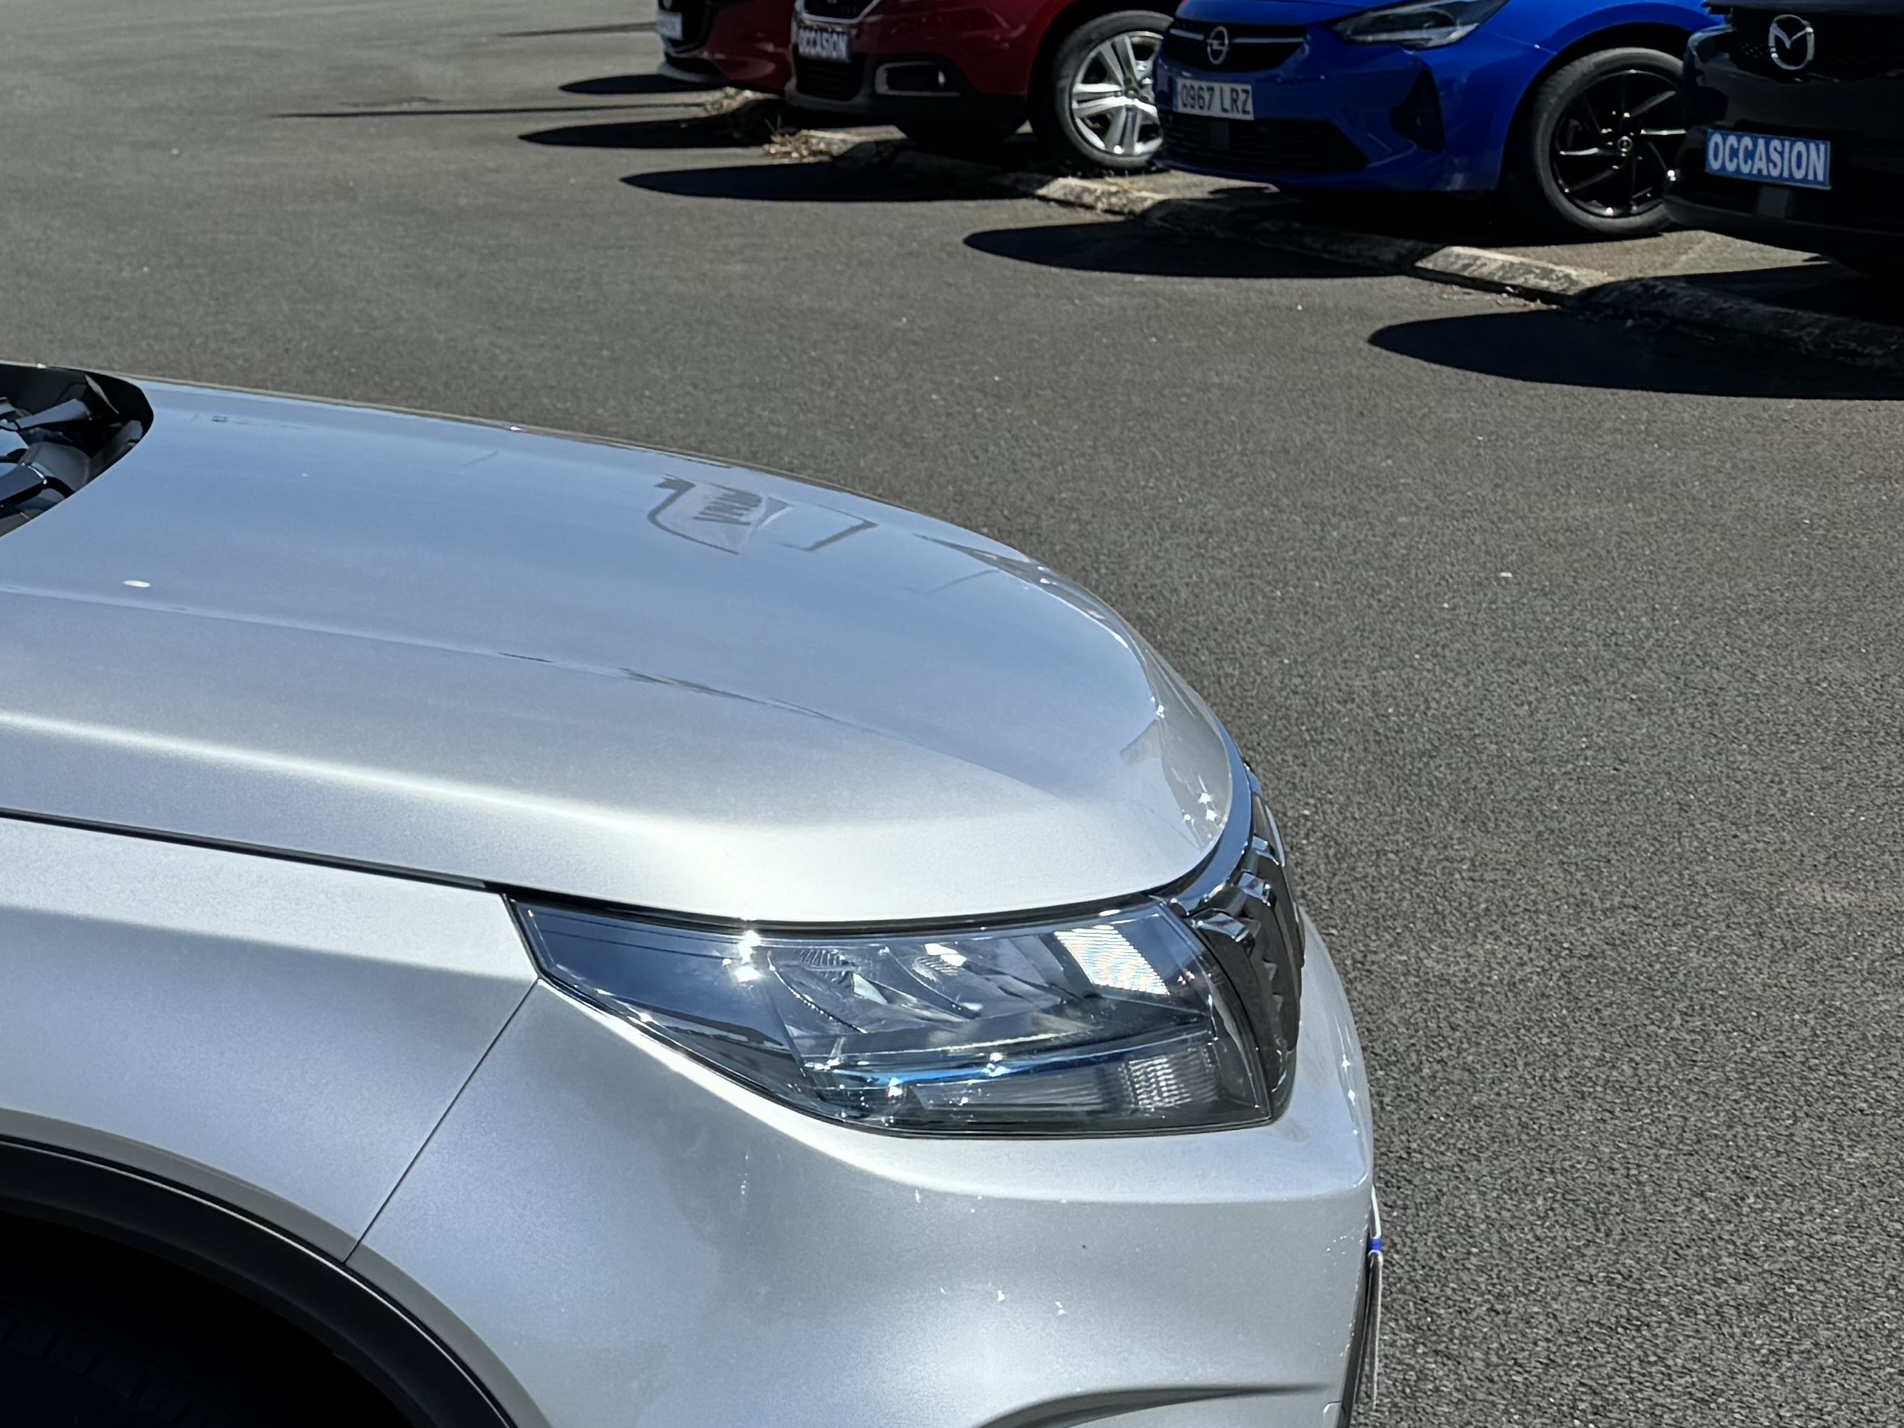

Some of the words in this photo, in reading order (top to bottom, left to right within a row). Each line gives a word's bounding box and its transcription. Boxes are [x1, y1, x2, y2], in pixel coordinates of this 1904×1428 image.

[798, 26, 851, 63] OCCASION
[1181, 82, 1215, 111] 0967
[1219, 86, 1250, 115] LRZ
[1707, 132, 1826, 182] OCCASION
